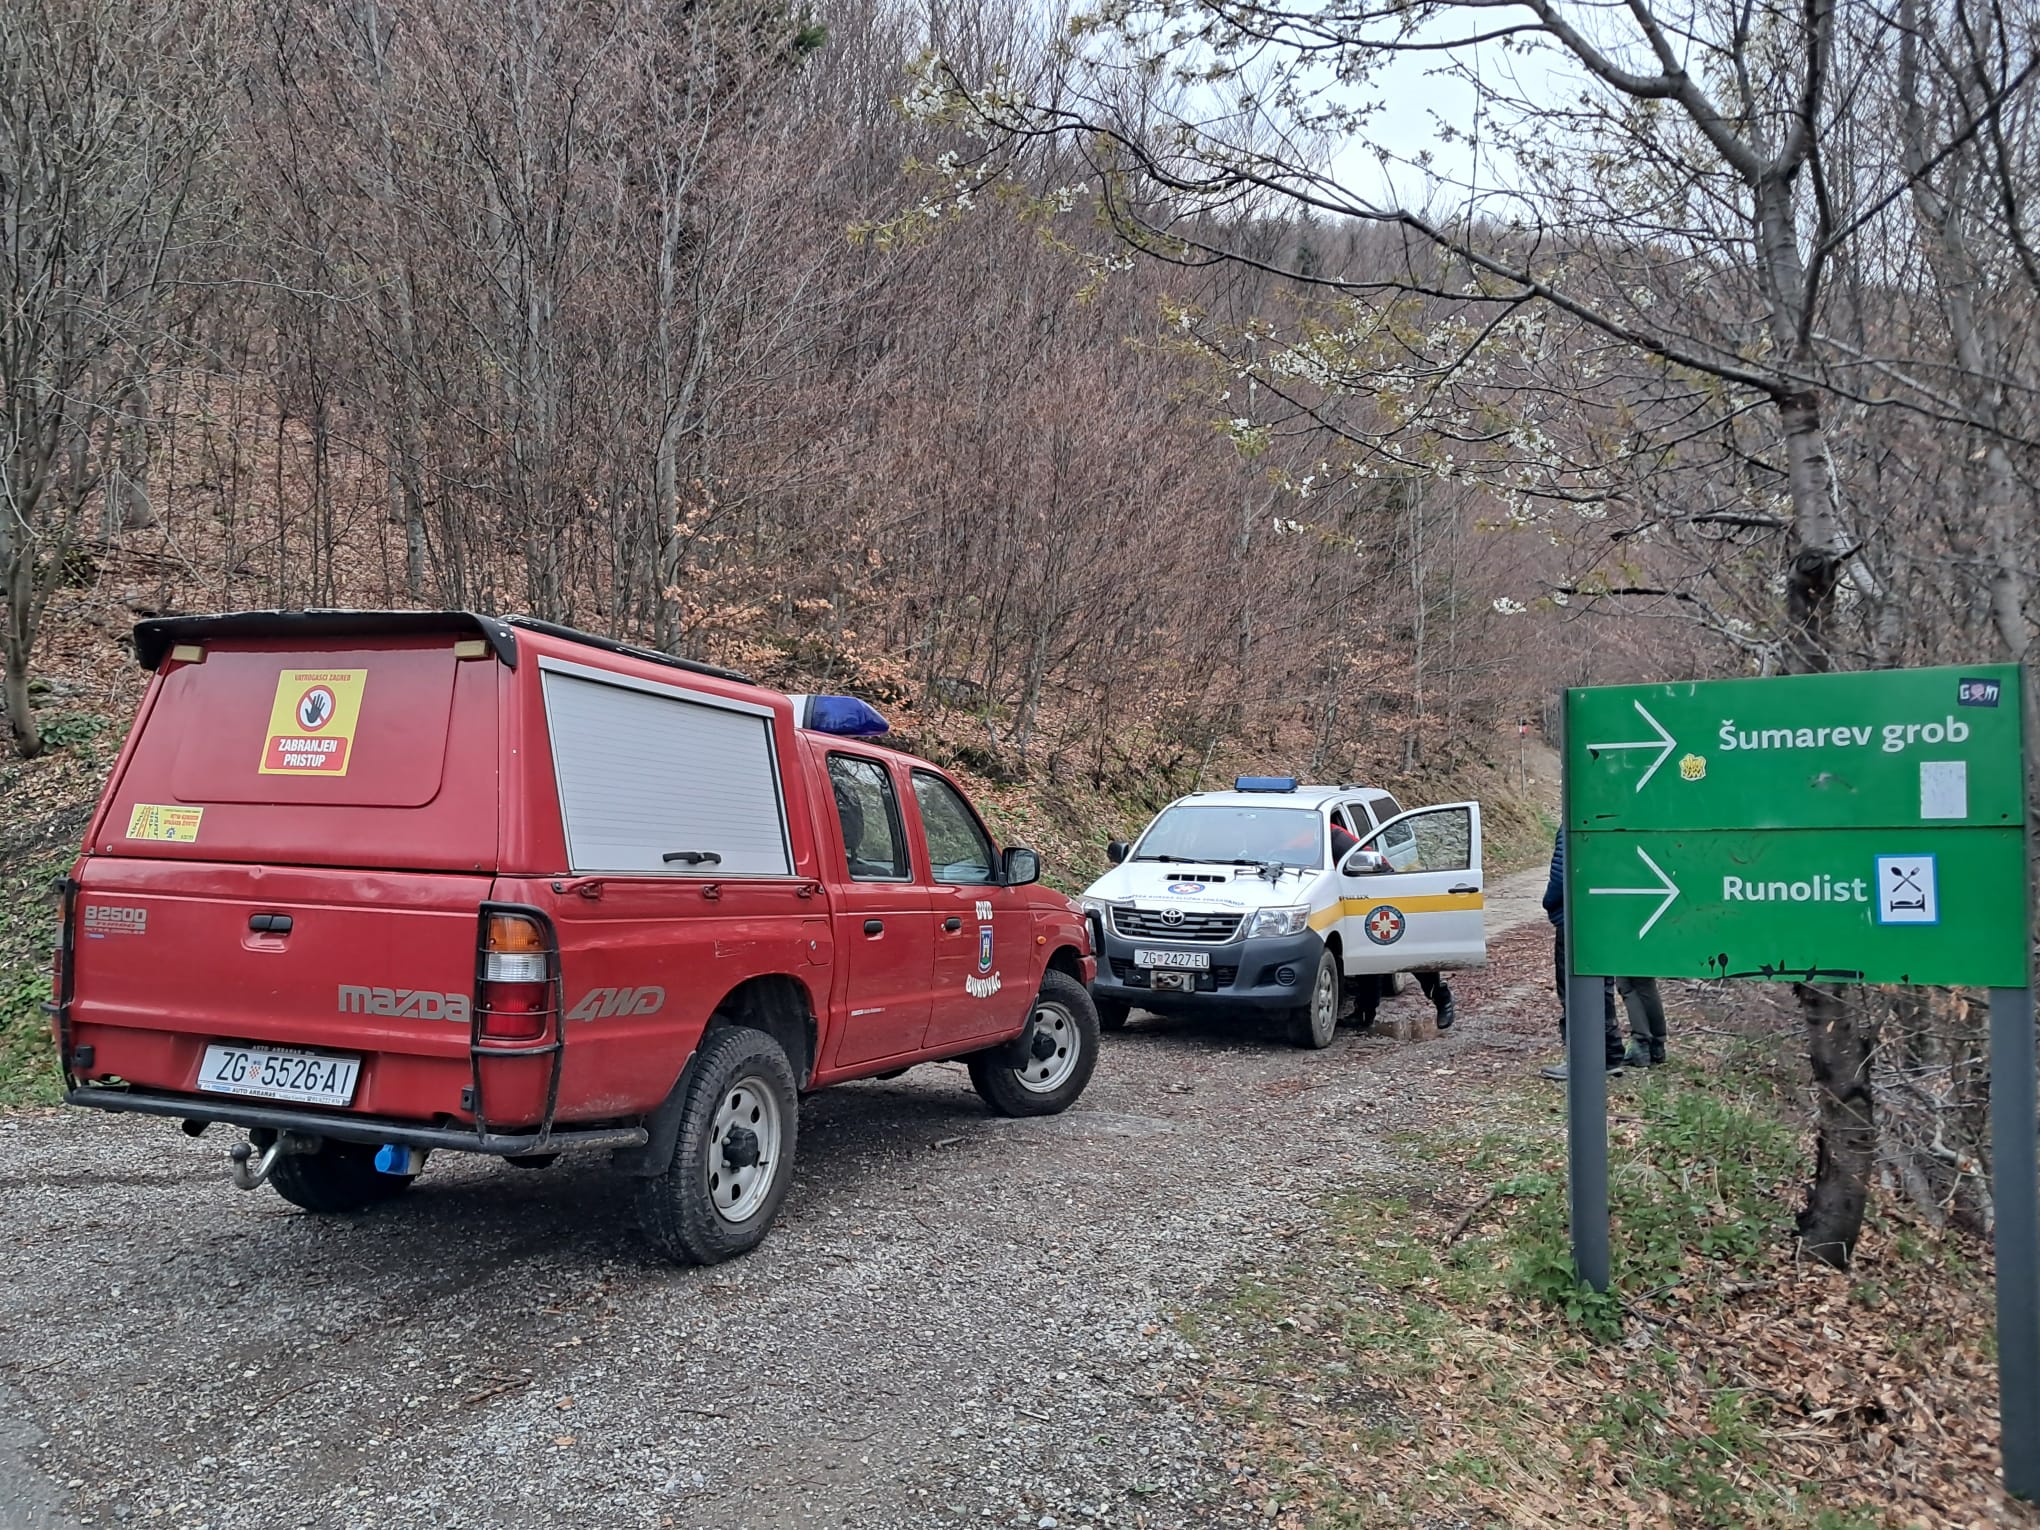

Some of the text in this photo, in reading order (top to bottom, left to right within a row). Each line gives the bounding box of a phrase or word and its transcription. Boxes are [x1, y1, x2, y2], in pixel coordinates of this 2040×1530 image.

[278, 738, 338, 753] ZABRANJEN
[1718, 715, 1970, 753] Šumarev grob
[283, 753, 326, 767] PRISTUP
[1722, 874, 1868, 902] Runolist
[84, 904, 148, 923] B2500
[975, 900, 993, 921] DVD
[1142, 951, 1157, 965] ZG
[965, 970, 1002, 999] BUKOVAC
[566, 985, 666, 1023] 4WD
[216, 1051, 249, 1083] ZG
